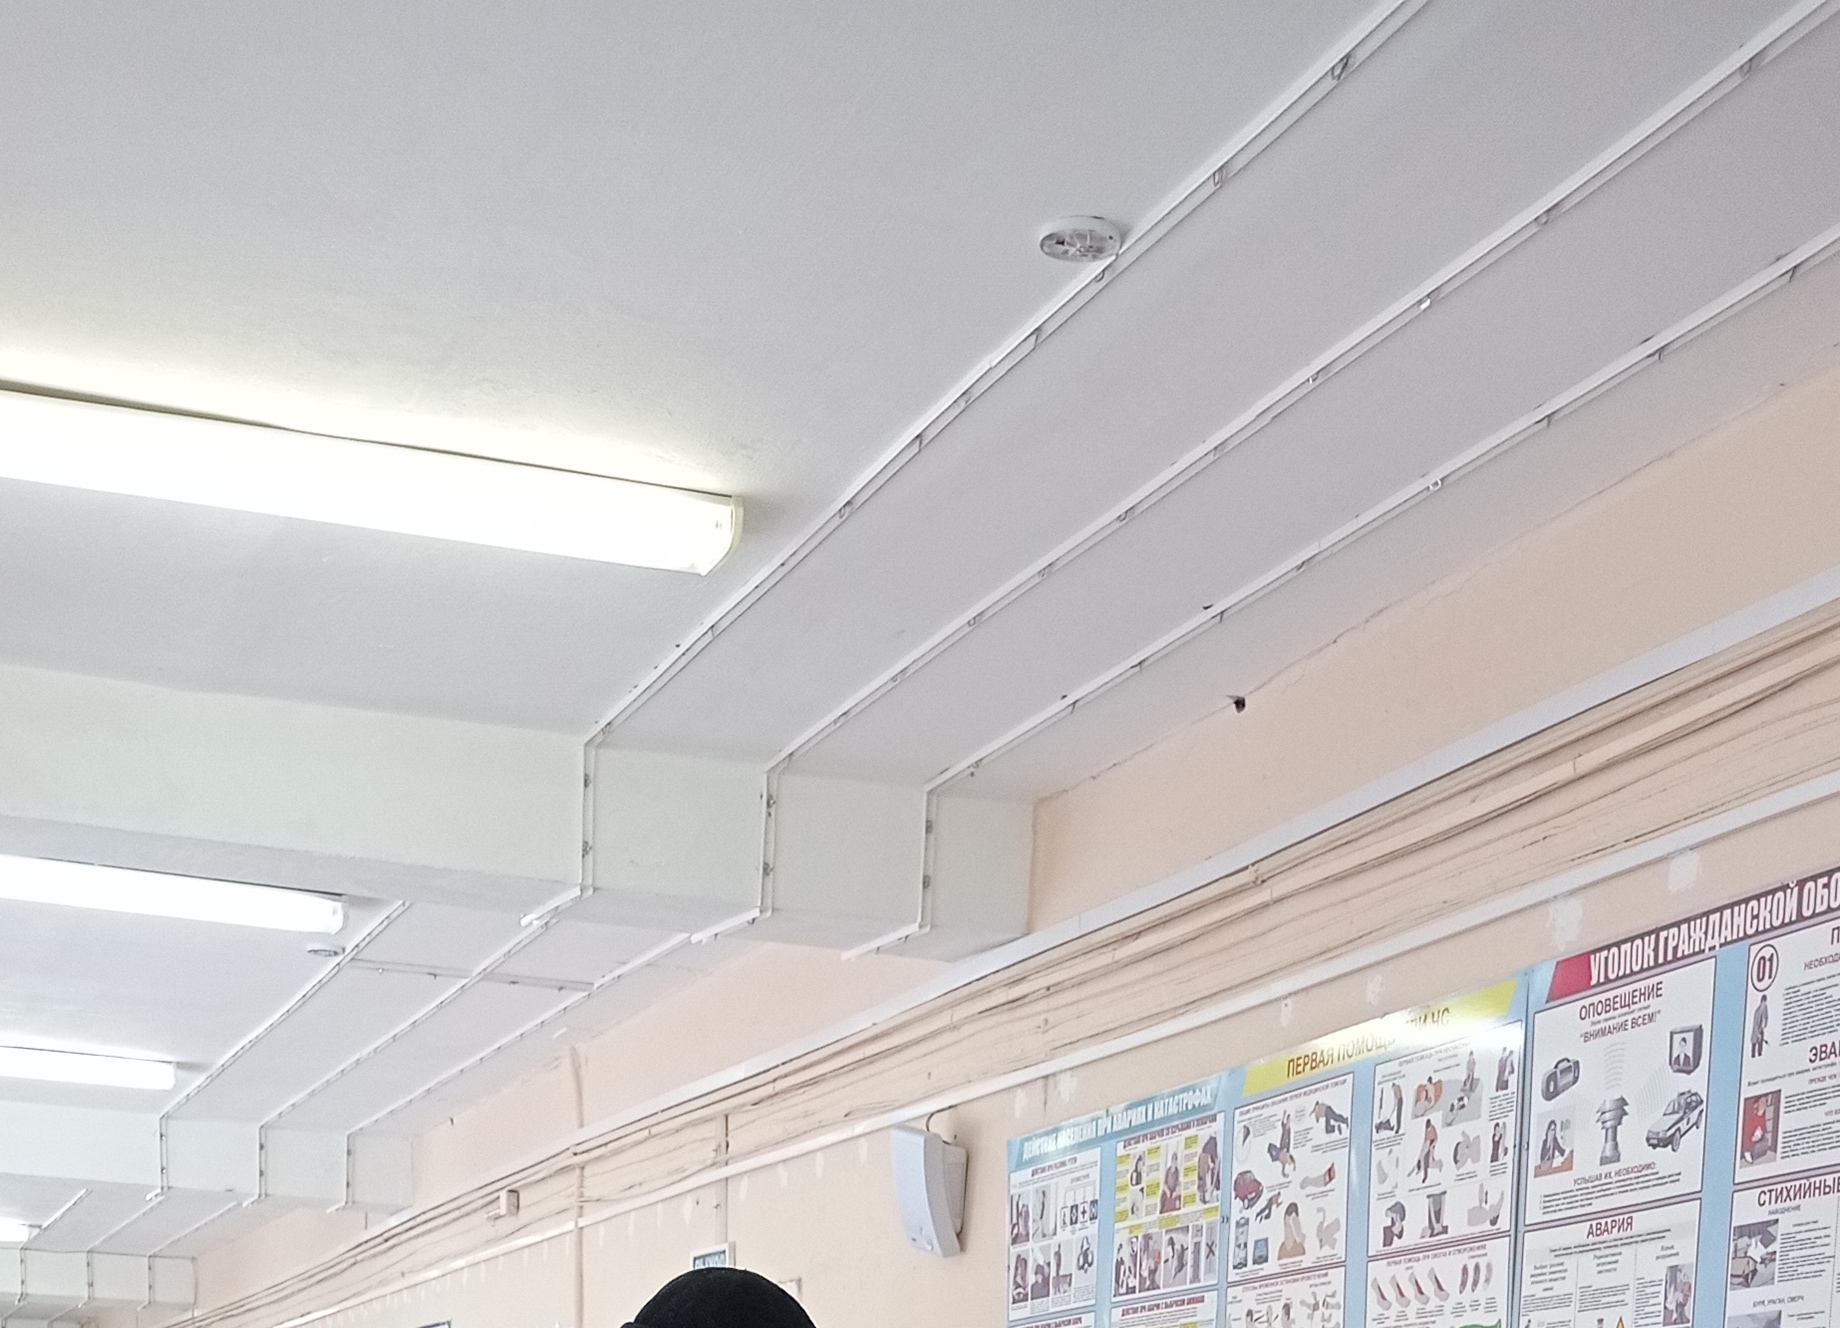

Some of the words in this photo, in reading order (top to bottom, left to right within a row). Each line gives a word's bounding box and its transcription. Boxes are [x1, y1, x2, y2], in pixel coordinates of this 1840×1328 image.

[1590, 935, 1656, 985] УГОЛОК
[1659, 881, 1799, 962] ГРАЖДАНСКОЙ
[1756, 952, 1775, 983] 01
[1804, 953, 1840, 971] НЕОБХОД
[1579, 981, 1663, 1021] ОПОВЕЩЕНИЕ
[1287, 1047, 1334, 1078] ПЕРВАЯ
[1809, 1040, 1840, 1063] ЭВА
[1587, 1216, 1633, 1239] АВАРИЯ
